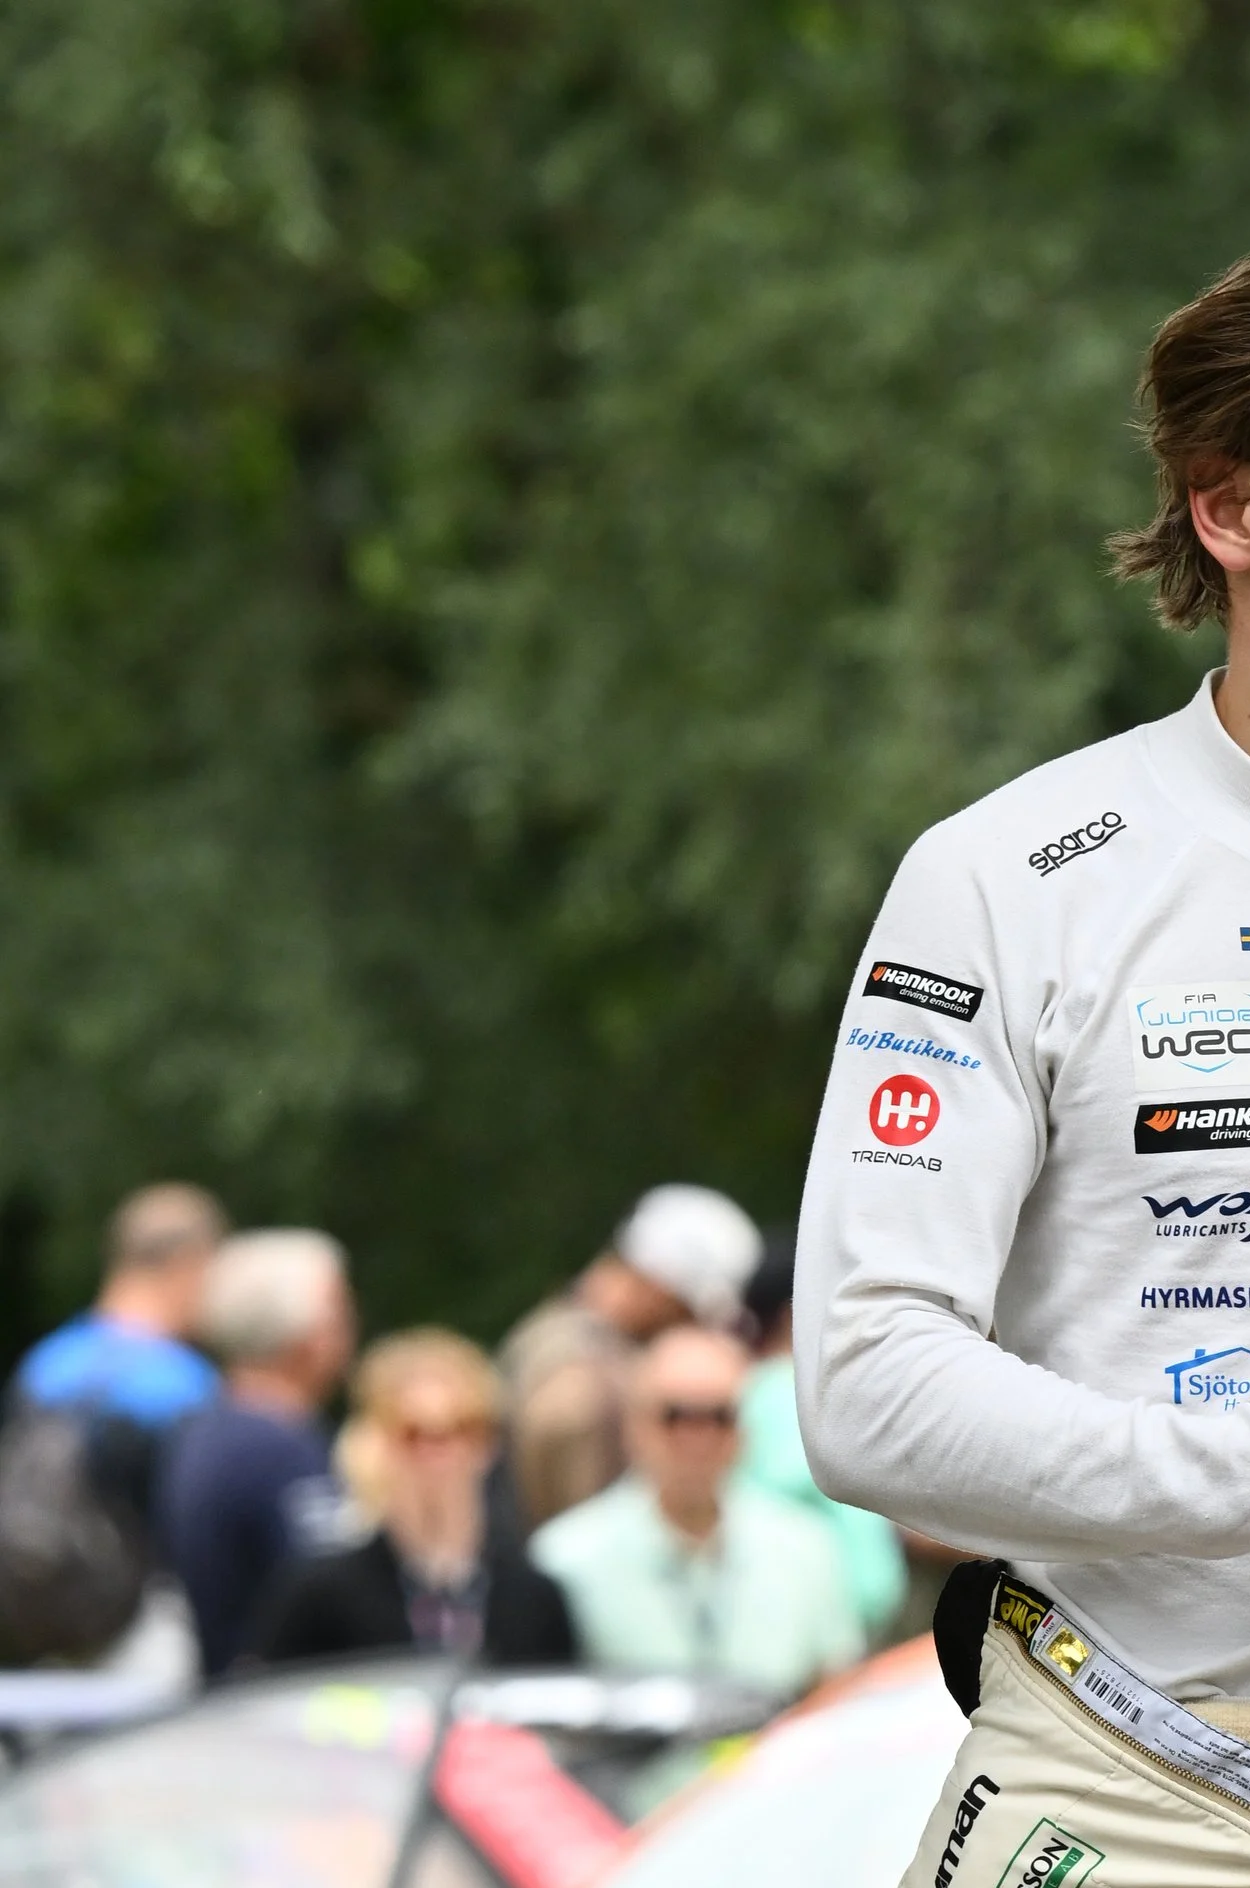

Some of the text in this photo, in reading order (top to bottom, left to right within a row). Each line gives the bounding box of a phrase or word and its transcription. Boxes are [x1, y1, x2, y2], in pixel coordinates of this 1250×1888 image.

[1029, 812, 1125, 874] sparco
[900, 988, 969, 1014] driving emotion
[1184, 993, 1216, 1004] FIA
[846, 1028, 981, 1070] HojButiken.se
[852, 1150, 942, 1172] TRENDAB
[1156, 1222, 1246, 1237] LUBRICANTS
[1000, 1597, 1042, 1639] OMP
[1062, 1853, 1080, 1872] AB
